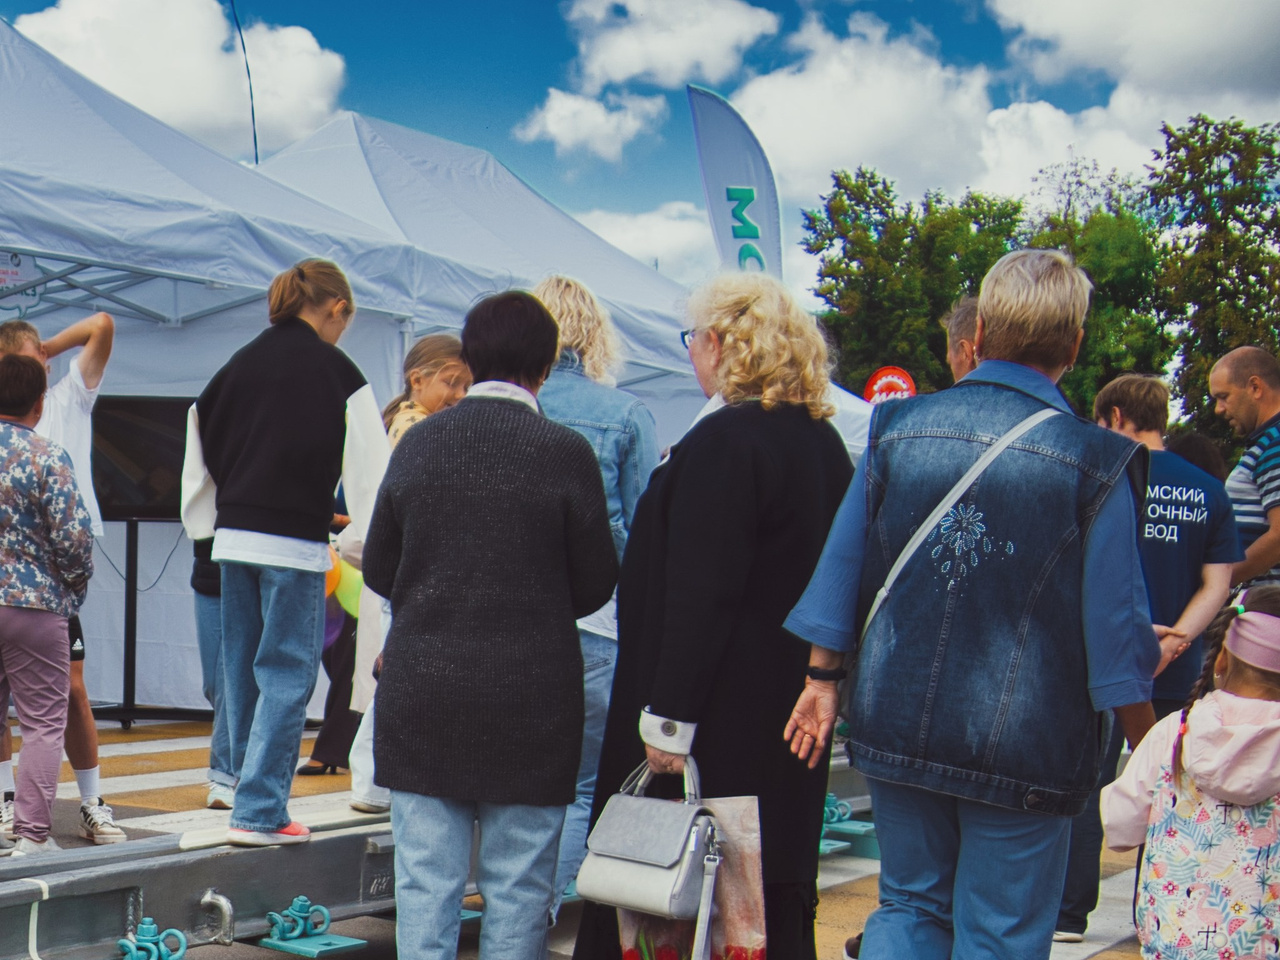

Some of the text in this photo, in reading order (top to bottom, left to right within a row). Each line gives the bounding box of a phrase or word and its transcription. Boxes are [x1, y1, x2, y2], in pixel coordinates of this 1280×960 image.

[1146, 485, 1205, 504] МСКИЙ
[1147, 503, 1208, 524] ОЧНЫЙ
[1144, 523, 1178, 542] ВОД
